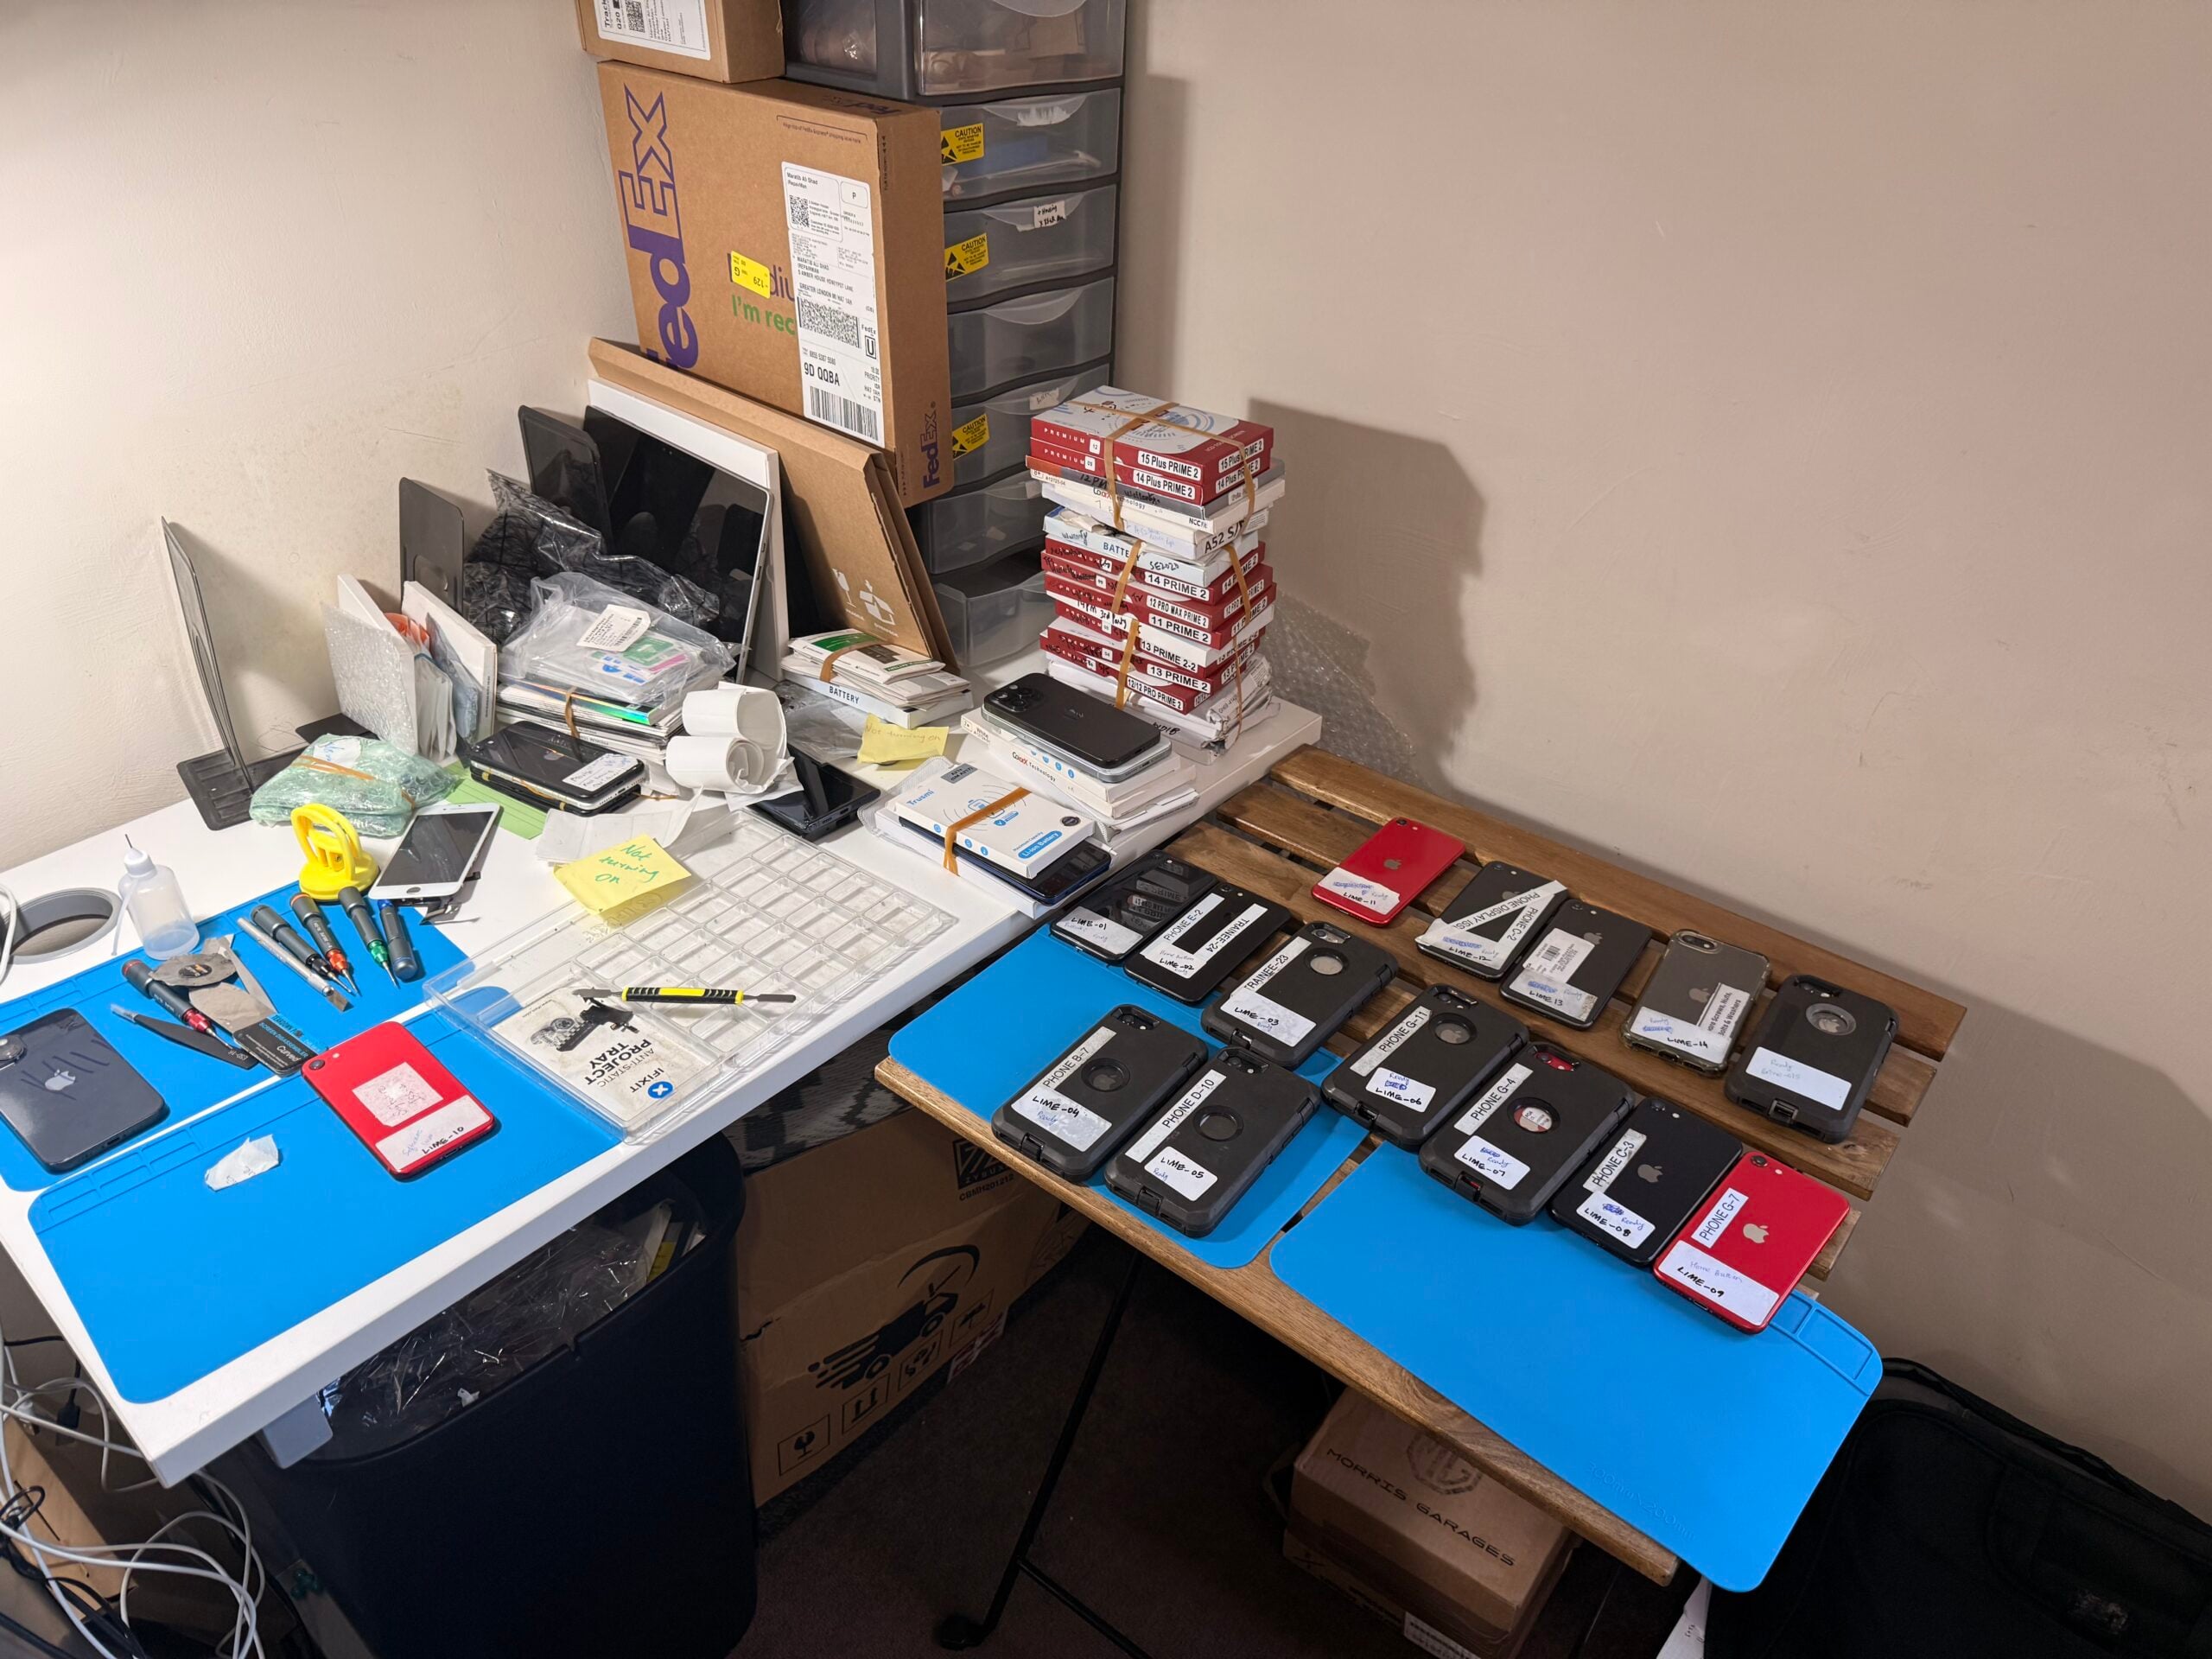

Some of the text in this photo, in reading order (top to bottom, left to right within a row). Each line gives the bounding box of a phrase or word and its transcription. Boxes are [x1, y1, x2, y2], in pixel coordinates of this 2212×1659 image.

[955, 126, 982, 138] CAUTION
[618, 84, 699, 369] edEx
[961, 235, 986, 251] CAUTION
[799, 283, 817, 293] GREATER
[817, 287, 831, 297] LONDON
[732, 295, 761, 324] I'm
[861, 324, 876, 334] FedEx
[867, 339, 874, 356] U
[804, 362, 840, 386] 9D QQBA
[864, 371, 880, 383] PRIORITY
[962, 415, 986, 434] CAUTION
[1044, 427, 1085, 444] PREMIUM
[1141, 453, 1198, 479] 15 Plus PRIME 2
[1221, 457, 1228, 470] 15
[1229, 454, 1240, 467] Plus
[1258, 440, 1262, 450] 2
[1136, 472, 1192, 498] 14 Plus PRIME 2
[1217, 460, 1259, 490] 14 Plus 2
[1103, 542, 1141, 562] BATTEY
[1205, 531, 1224, 554] A52
[1147, 574, 1206, 599] 14 PRIME 2
[1224, 579, 1231, 590] 14
[1149, 597, 1207, 626] 12 PRO MAX PRIME 2
[1151, 616, 1209, 643] 11 PRIME 2
[1233, 624, 1240, 634] 11
[1141, 640, 1196, 671] 13 PRIME 2-2
[1150, 666, 1208, 690] 13 PRIME 2
[829, 685, 860, 704] BATTERY
[1128, 678, 1182, 709] 12/12 PRO PRIME 2
[1028, 761, 1056, 782] Technology
[906, 788, 934, 805] Trusmi
[1038, 832, 1059, 846] Battery
[620, 844, 652, 861] Not
[1507, 892, 1541, 908] PHONE
[1071, 917, 1107, 931] LIME-01
[1473, 901, 1509, 924] DISPLAY
[1506, 906, 1539, 941] PHONE C-2
[1163, 909, 1204, 941] PHONE E-2
[1205, 918, 1249, 953] TRAINEE-24
[1160, 958, 1195, 970] LIME-02
[1448, 947, 1492, 962] LIME-12
[1244, 954, 1290, 991] TRAINEE-23
[1711, 991, 1732, 1024] Screws, Nuts,
[1727, 999, 1741, 1020] Washers
[1379, 1010, 1428, 1052] PHONE G-11
[1667, 1037, 1708, 1049] LIME-14
[276, 1046, 302, 1062] Curved
[584, 1039, 652, 1086] PROJECT
[589, 1042, 629, 1070] TRAY
[600, 1048, 655, 1088] ANTI-STATIC
[1043, 1046, 1089, 1088] PHONE B-7
[630, 1067, 664, 1093] IFIXIT
[1033, 1096, 1080, 1117] LIME-04
[1162, 1078, 1215, 1128] PHONE D-10
[1376, 1087, 1422, 1105] LIME-06
[1471, 1077, 1516, 1121] PHONE G-4
[422, 1126, 465, 1154] LIME-10
[1462, 1153, 1506, 1177] LIME-07
[1592, 1141, 1635, 1187] PHONE C-3
[1585, 1207, 1632, 1237] LIME-08
[1699, 1192, 1740, 1241] PHONE G-7
[1677, 1266, 1725, 1298] LIME-09
[1326, 1447, 1516, 1567] MORRIS GARAGES
